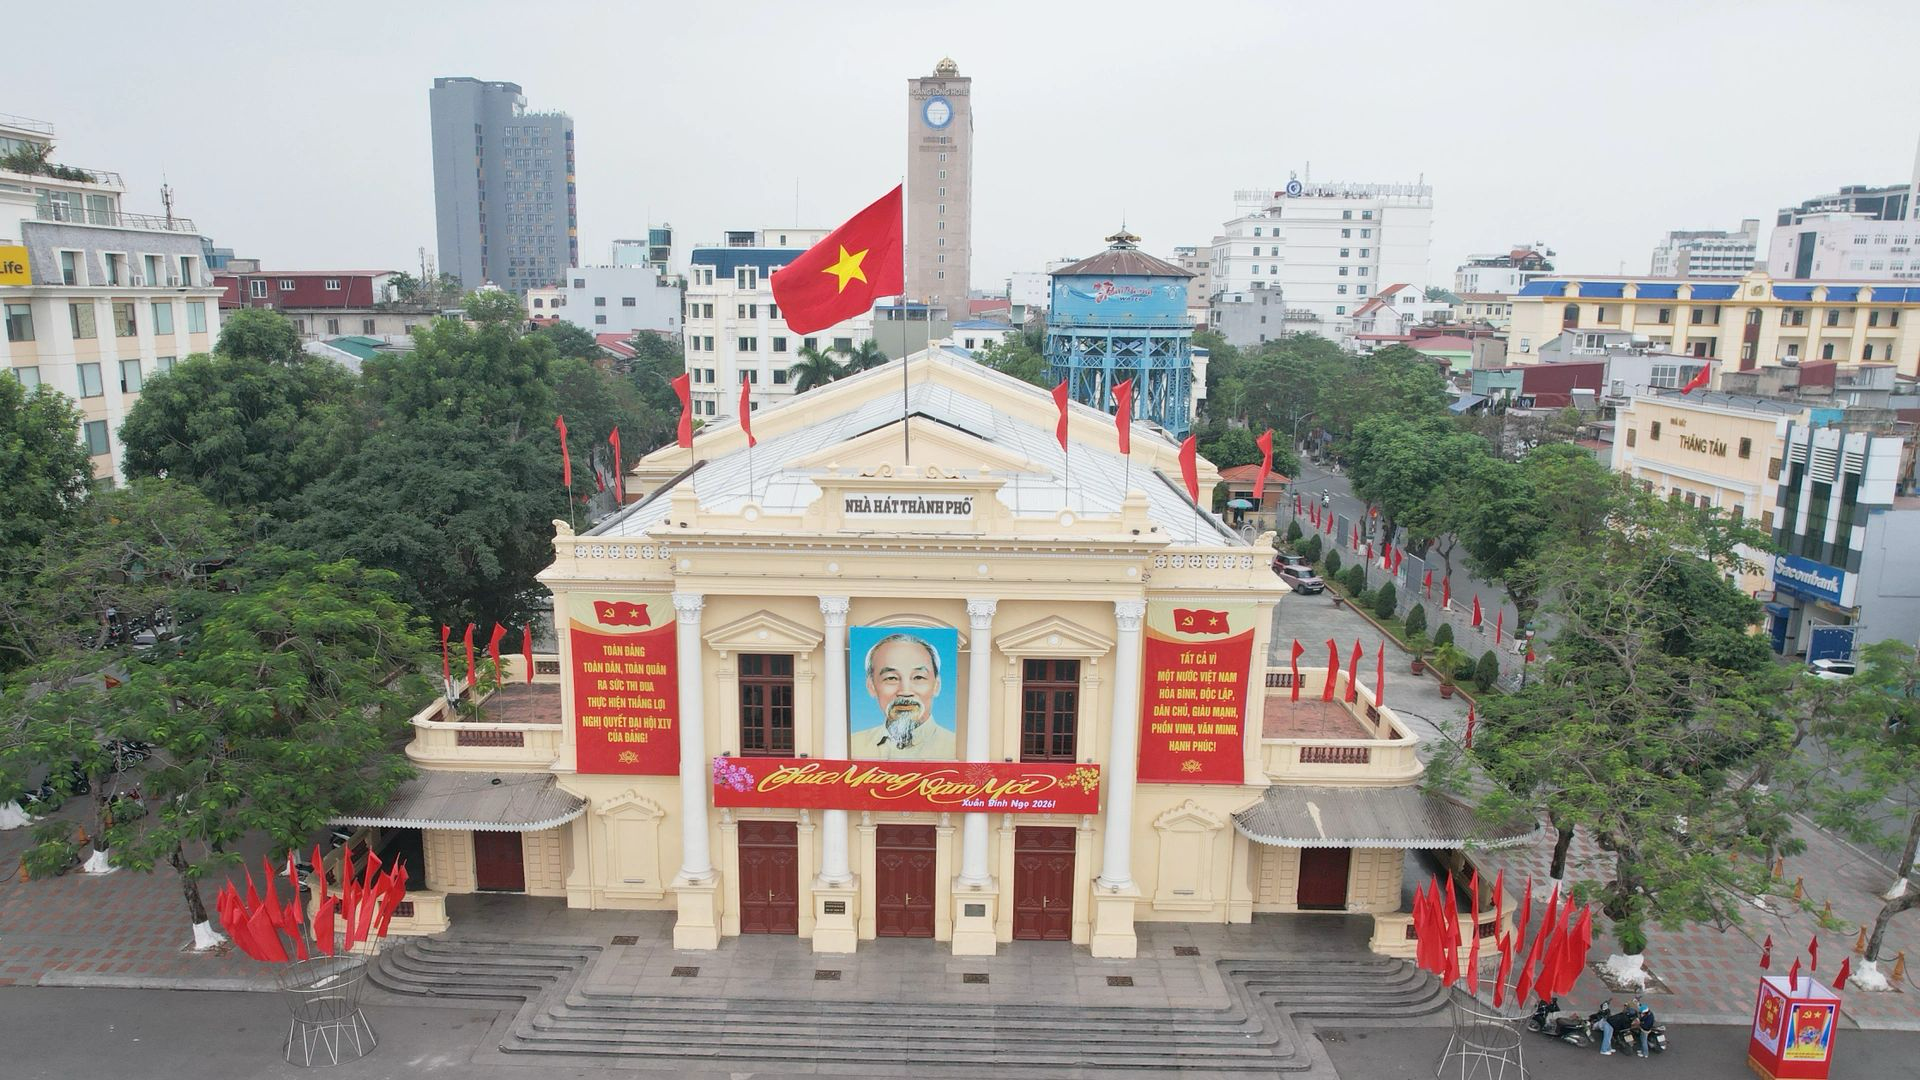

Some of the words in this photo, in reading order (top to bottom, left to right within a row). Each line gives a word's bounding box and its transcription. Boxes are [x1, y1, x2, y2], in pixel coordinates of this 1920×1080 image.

[1680, 434, 1708, 453] THÁNG
[1709, 438, 1727, 457] TÁM
[845, 496, 872, 513] NHÀ
[873, 496, 899, 513] HÁT
[900, 496, 945, 514] THÀNH
[945, 497, 974, 515] PHỐ
[1775, 556, 1839, 593] Sacombank
[603, 643, 623, 656] TOÀN
[624, 643, 645, 657] ĐẢNG
[1180, 650, 1195, 665] TẤT
[1196, 650, 1207, 665] CẢ
[1209, 652, 1217, 665] VÌ
[583, 660, 603, 673] TOÀN
[605, 661, 624, 675] DÂN,
[625, 661, 644, 675] TOÀN
[645, 662, 667, 676] QUÂN
[1157, 668, 1175, 684] MỘT
[1176, 669, 1198, 682] NƯỚC
[1200, 670, 1217, 685] VIỆT
[1218, 672, 1238, 683] NAM
[597, 680, 608, 690] RA
[609, 678, 625, 691] SỨC
[626, 681, 638, 691] THI
[639, 681, 655, 692] ĐUA
[1159, 686, 1175, 699] HÒA
[1177, 686, 1198, 700] BÌNH,
[1200, 687, 1216, 702] ĐỘC
[1218, 688, 1235, 702] LẬP,
[587, 697, 607, 710] THỰC
[608, 696, 626, 710] HIỆN
[627, 694, 653, 709] THẮNG
[653, 698, 666, 712] LỢI
[1153, 704, 1170, 717] DÂN
[1172, 702, 1190, 718] CHỦ,
[1192, 704, 1211, 717] GIÀU
[1212, 706, 1239, 720] MẠNH,
[582, 716, 602, 730] NGHỊ
[603, 713, 627, 728] QUYẾT
[628, 717, 642, 731] ĐẠI
[643, 715, 657, 731] HỘI
[657, 718, 672, 730] XIV
[1175, 723, 1196, 735] VINH,
[1197, 722, 1213, 735] VĂN
[1215, 724, 1239, 737] MINH,
[607, 728, 623, 743] CỦA
[624, 729, 648, 743] ĐẢNG!
[1169, 740, 1191, 754] HẠNH
[1192, 739, 1217, 752] PHÚC!
[757, 763, 840, 793] Chúc
[833, 764, 922, 793] Mừng
[908, 770, 981, 802] Năm
[976, 773, 1057, 800] Mới
[962, 798, 985, 807] Xuân
[987, 799, 1008, 808] Bính
[1011, 800, 1029, 810] Ngọ
[1032, 800, 1056, 809] 2026!
